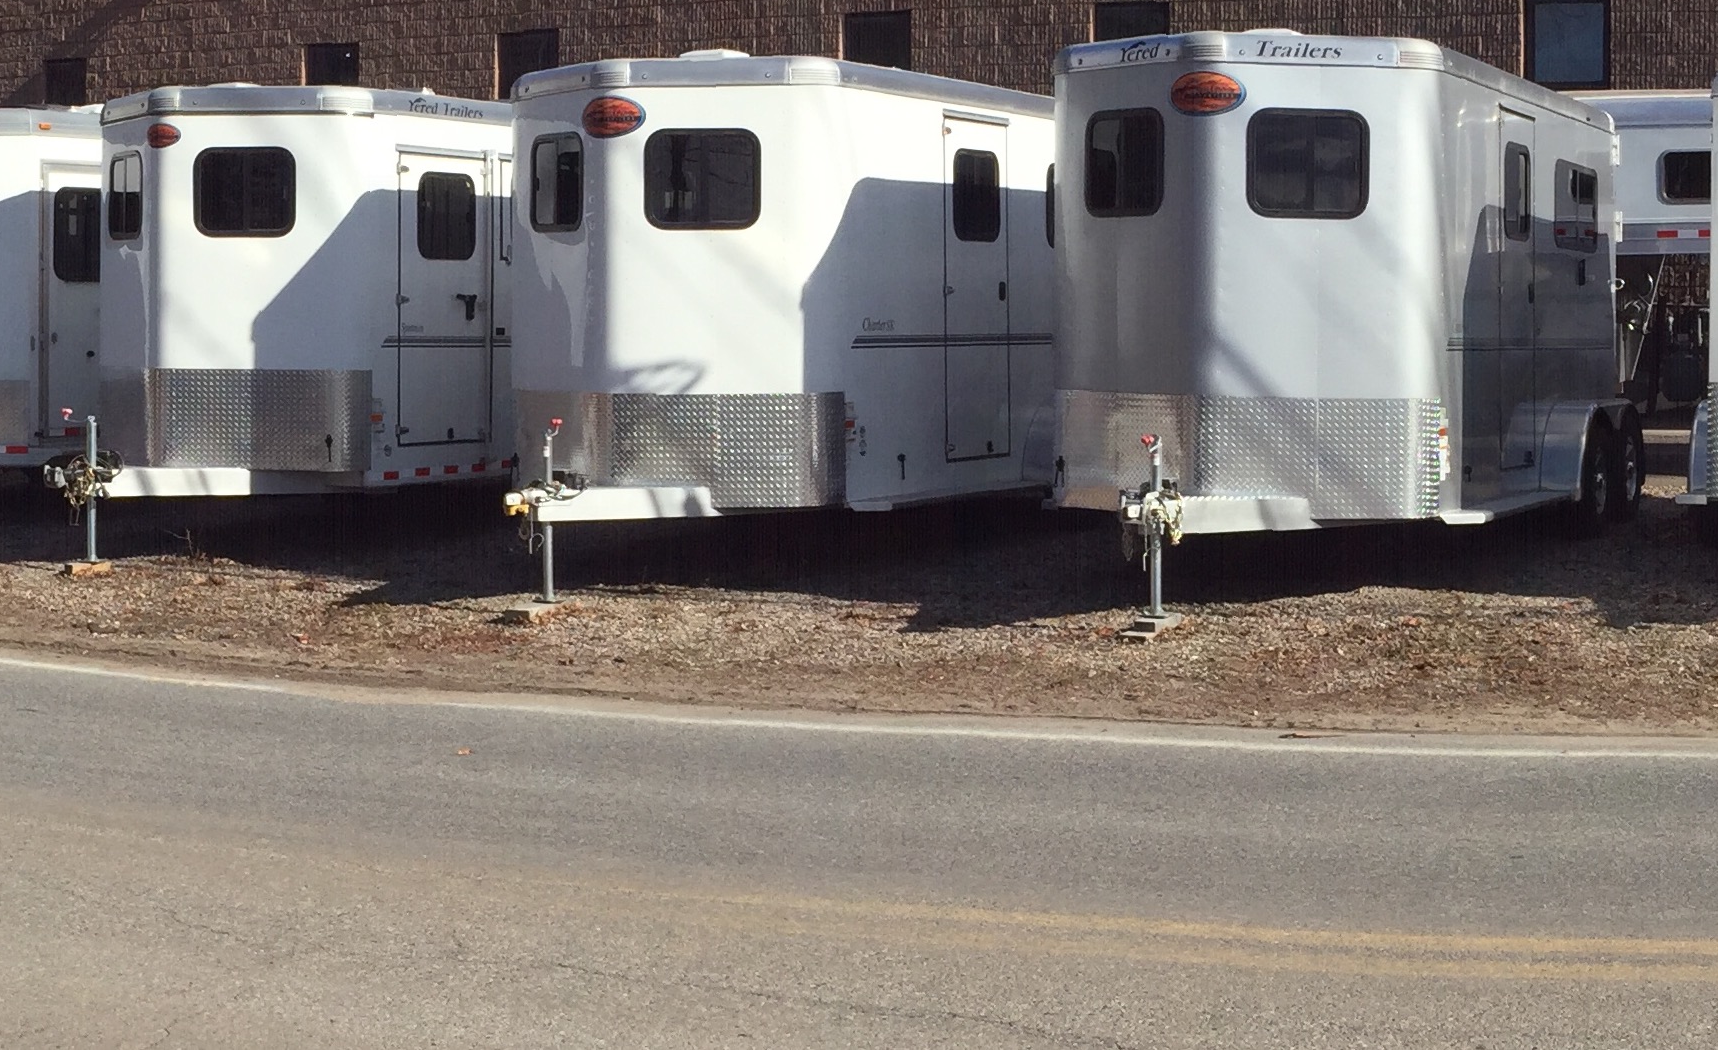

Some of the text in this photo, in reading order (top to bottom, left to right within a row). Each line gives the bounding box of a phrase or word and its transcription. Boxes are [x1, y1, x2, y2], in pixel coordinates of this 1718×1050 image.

[1119, 40, 1344, 62] Yered Trailers
[407, 98, 484, 119] Yered Trailers
